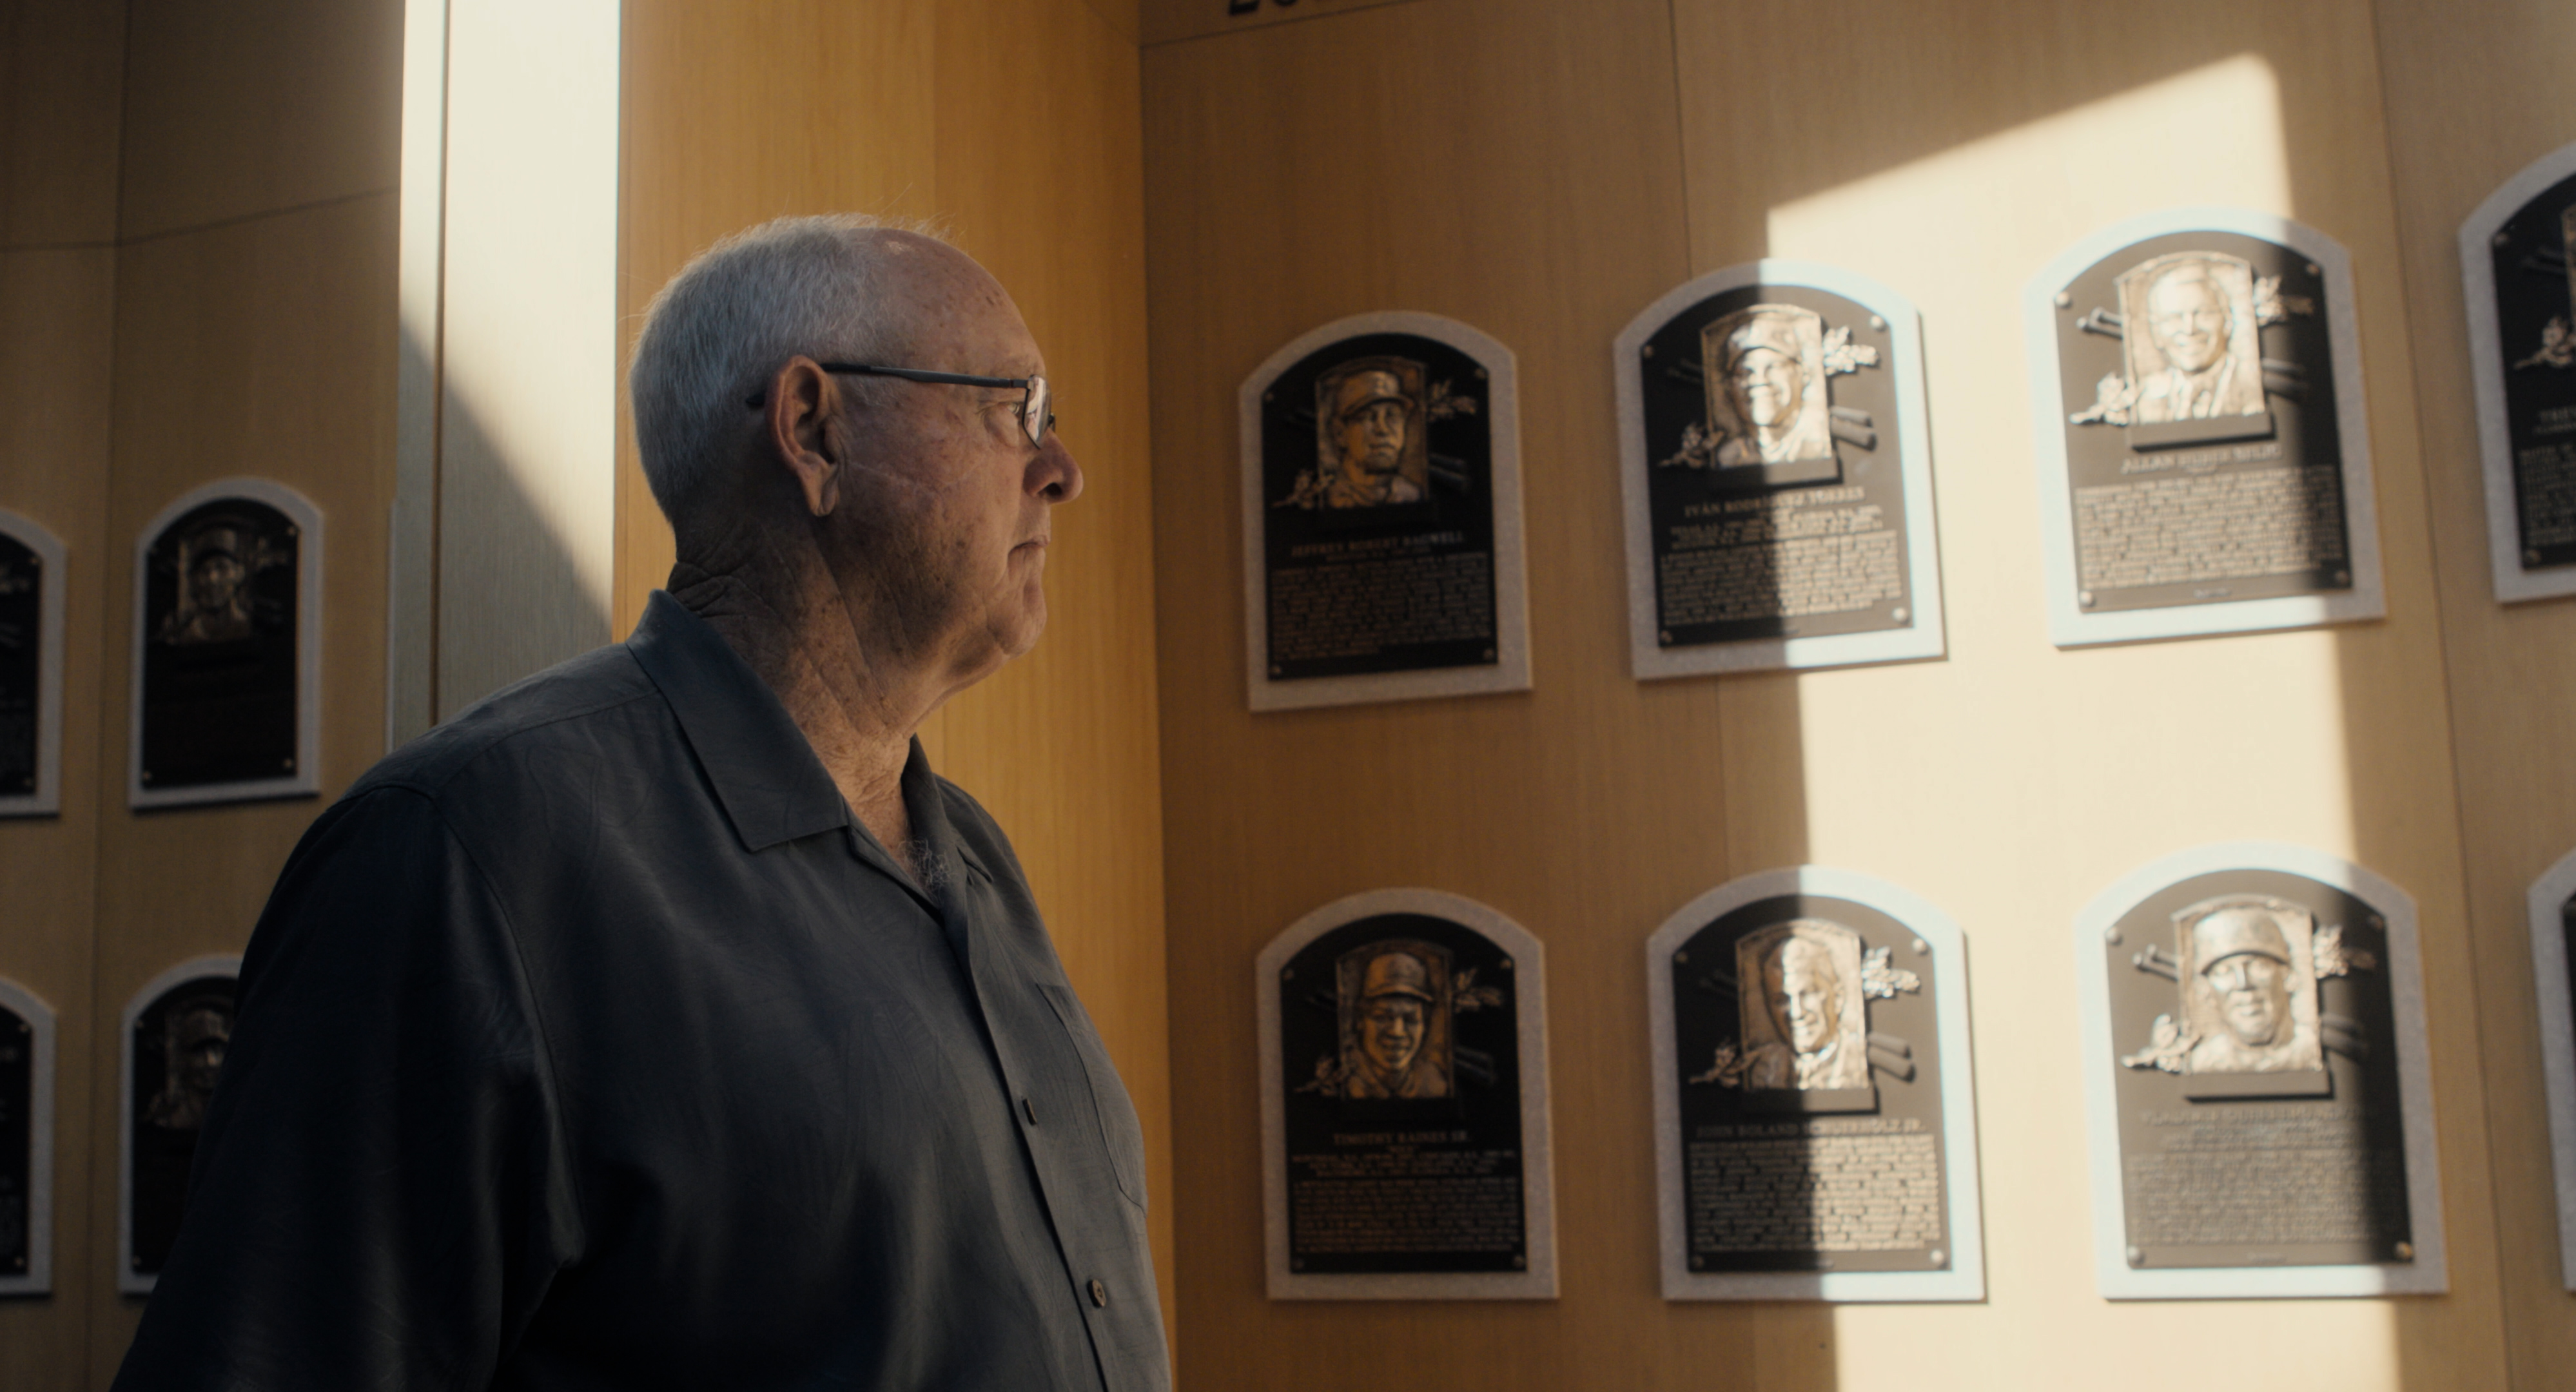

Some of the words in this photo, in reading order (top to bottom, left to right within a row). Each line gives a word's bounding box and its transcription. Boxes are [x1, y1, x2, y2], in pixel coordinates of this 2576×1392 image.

[1347, 536, 1398, 552] ROBERT
[1332, 1132, 1393, 1146] TIMOTHY
[1397, 1131, 1447, 1143] RAINES
